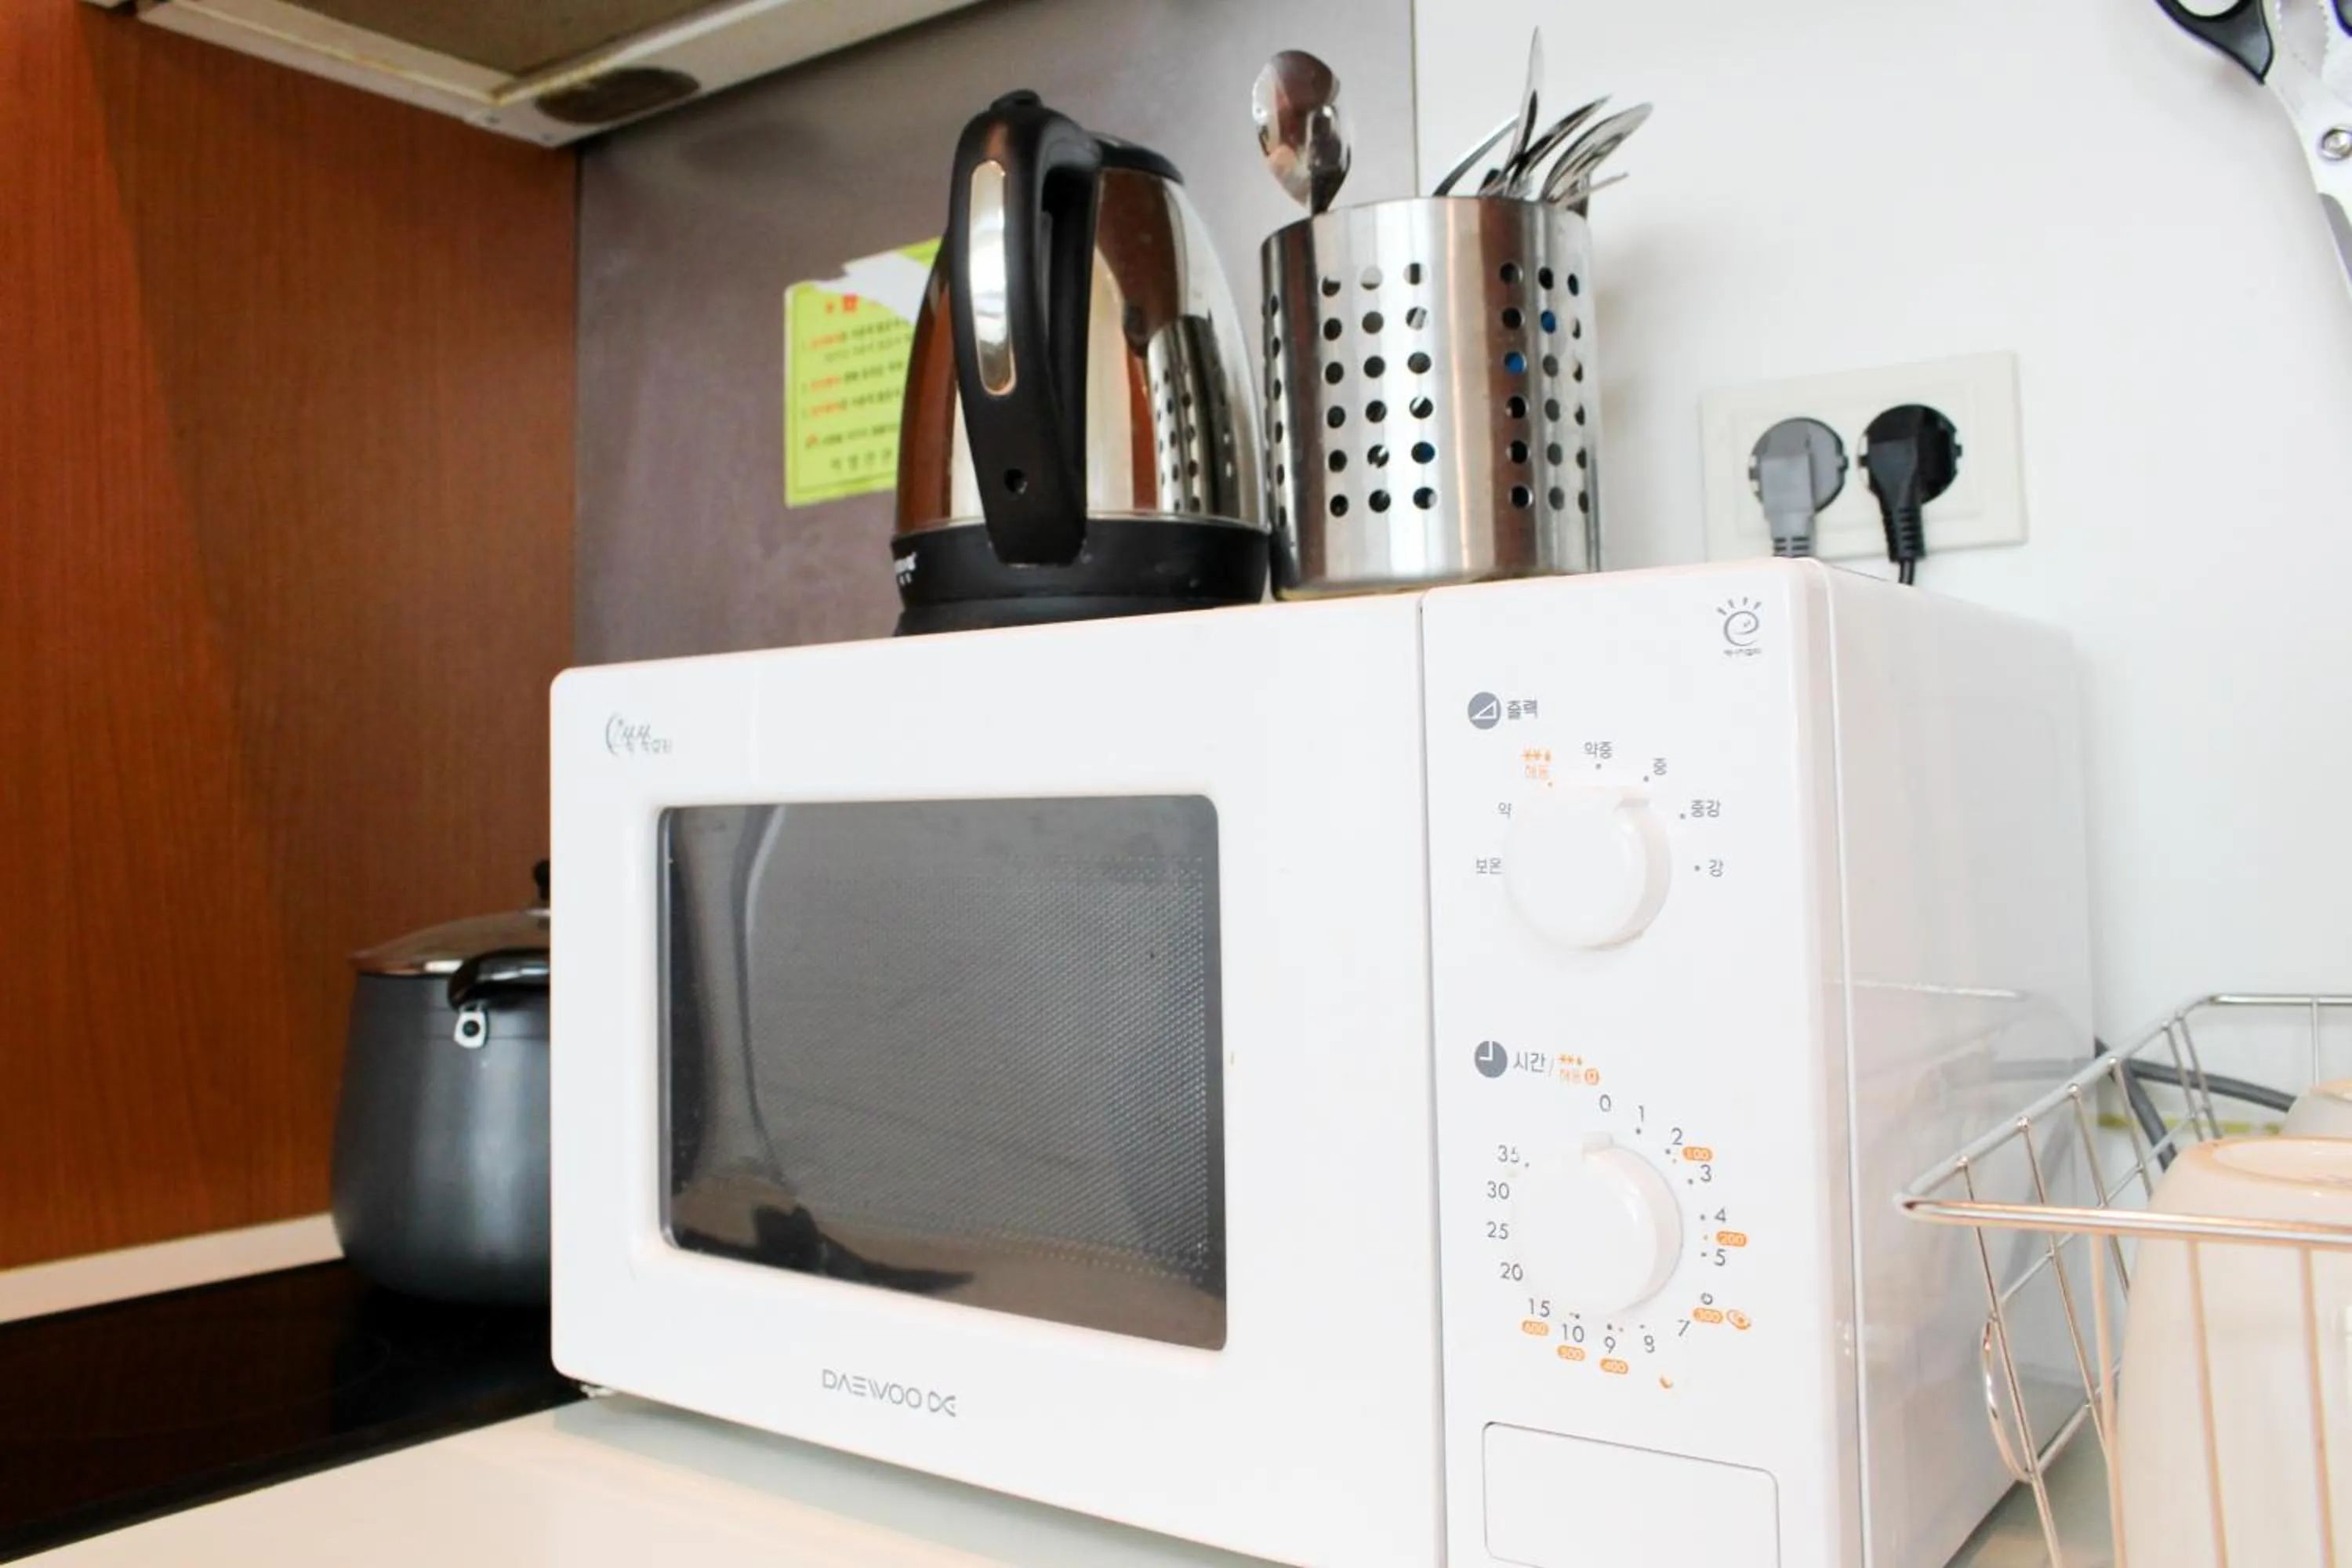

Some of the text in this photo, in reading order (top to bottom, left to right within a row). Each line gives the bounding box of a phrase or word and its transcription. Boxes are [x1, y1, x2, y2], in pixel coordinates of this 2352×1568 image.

[1508, 700, 1537, 720] 출력
[1584, 741, 1612, 759] 약중
[1653, 757, 1667, 775] 중
[1498, 801, 1512, 818] 약
[1691, 799, 1721, 818] 중강
[1475, 858, 1503, 875] 보온
[1708, 858, 1724, 877] 강
[1599, 1094, 1612, 1112] 0
[1637, 1105, 1645, 1122] 1
[1671, 1127, 1683, 1145] 2
[1700, 1164, 1712, 1182] 3
[1486, 1181, 1510, 1200] 30
[1715, 1207, 1726, 1223] 4
[1486, 1221, 1509, 1240] 25
[1714, 1249, 1726, 1266] 5
[1500, 1262, 1523, 1282] 20
[1528, 1298, 1551, 1318] 15
[1561, 1323, 1584, 1343] 10
[1677, 1319, 1690, 1337] 7
[1604, 1337, 1617, 1354] 9
[822, 1369, 922, 1409] DAEWOO
